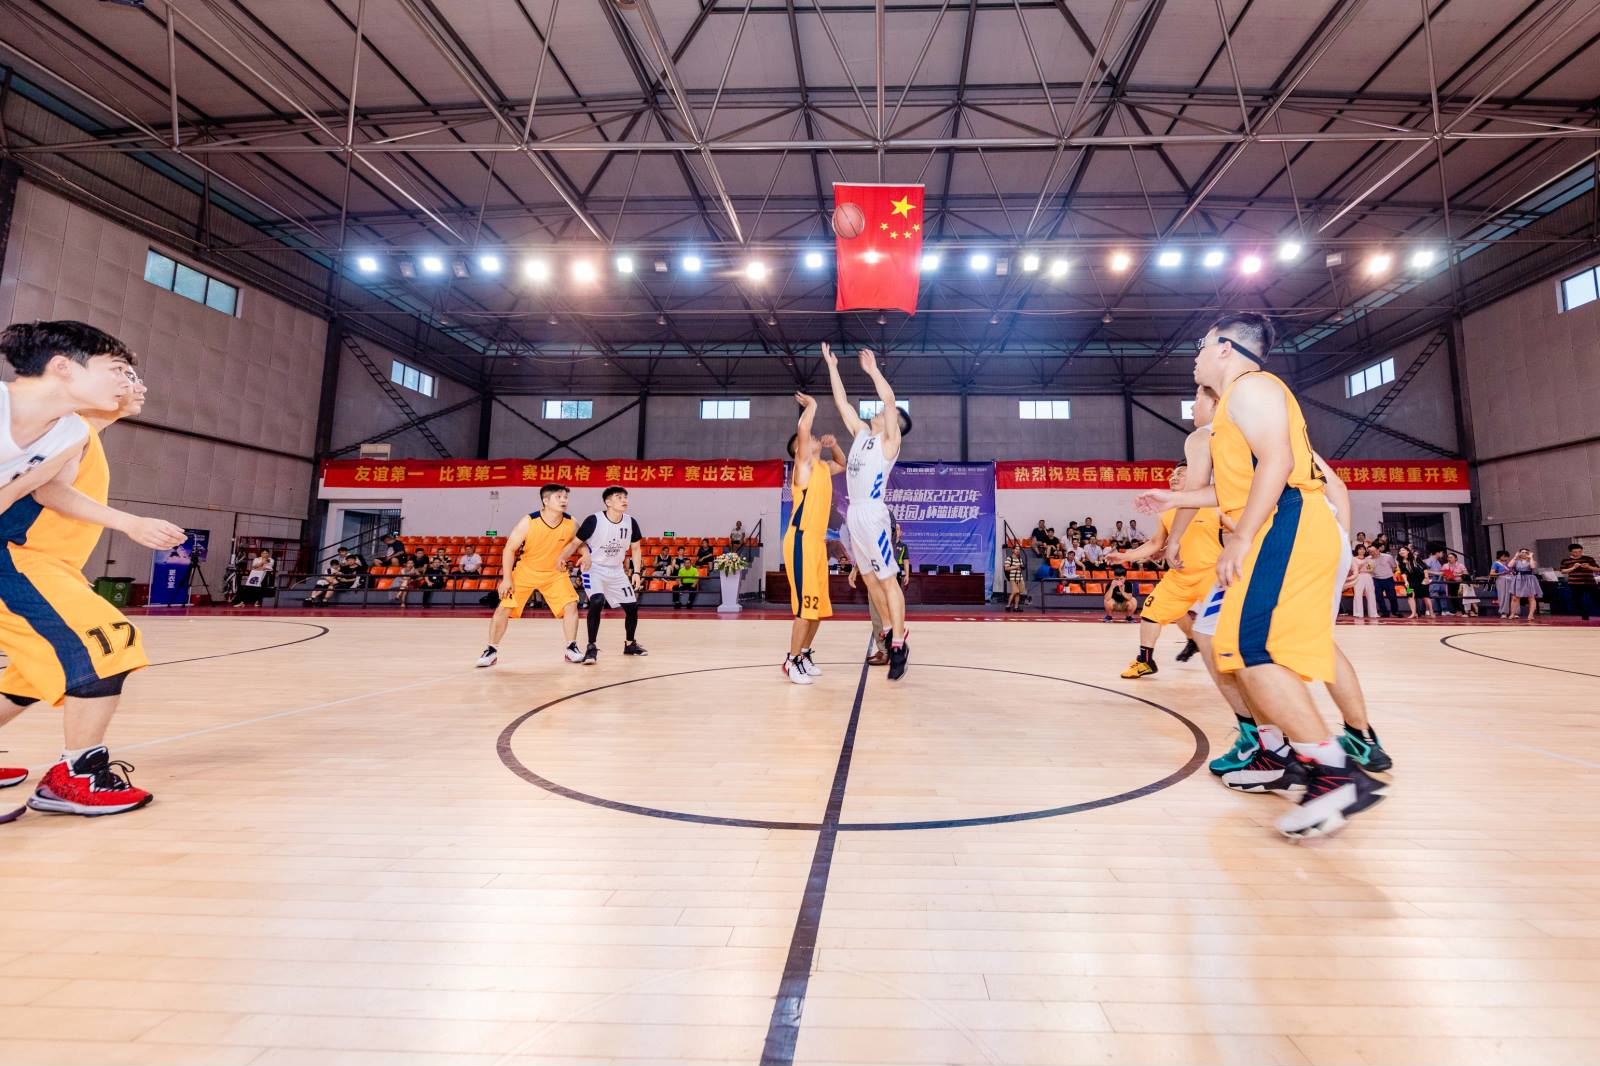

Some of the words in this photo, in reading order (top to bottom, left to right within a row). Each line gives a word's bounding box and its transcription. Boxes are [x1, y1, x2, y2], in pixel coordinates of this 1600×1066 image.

[354, 466, 424, 482] 友谊第一
[439, 466, 507, 482] 比赛第二
[522, 465, 591, 482] 赛出风格
[605, 465, 674, 482] 赛出水平
[685, 465, 754, 482] 赛出友谊
[620, 528, 628, 539] 11
[622, 586, 633, 597] 11
[804, 595, 819, 610] 32
[86, 621, 137, 657] 17
